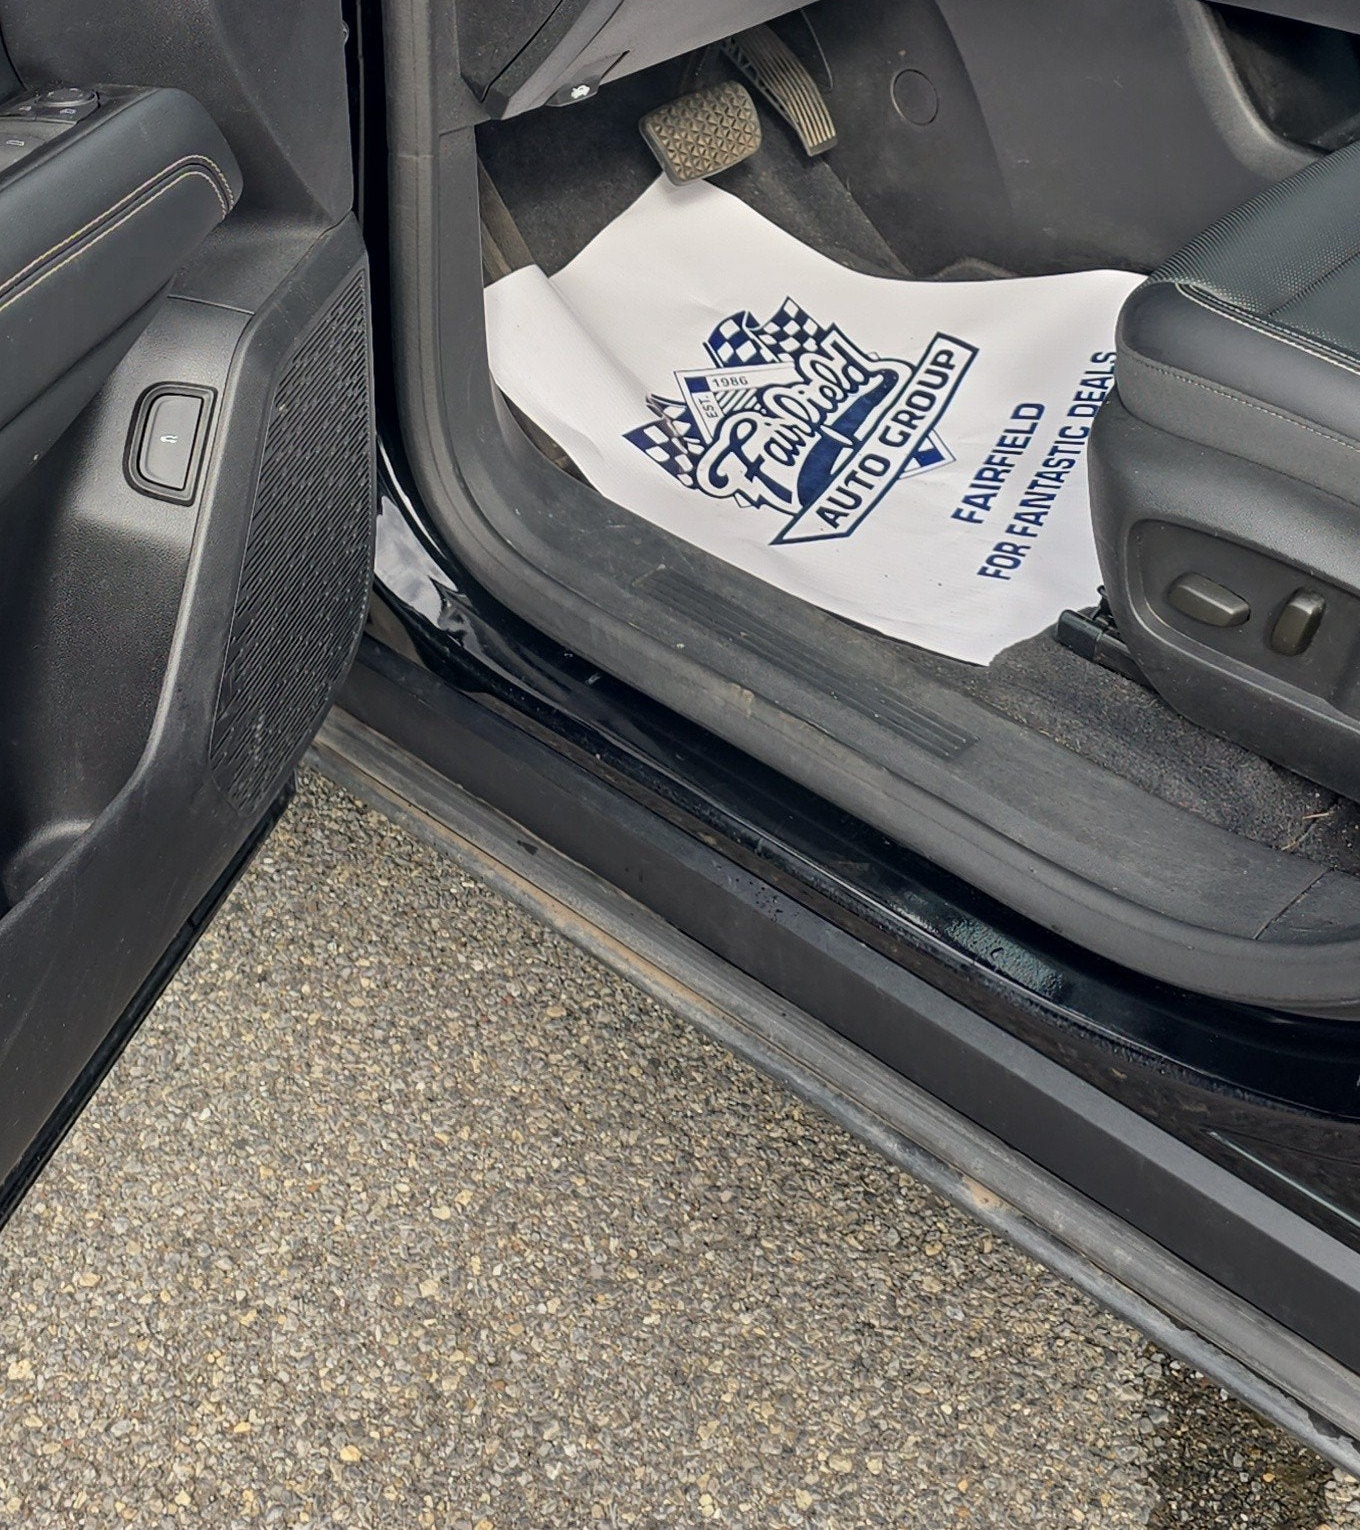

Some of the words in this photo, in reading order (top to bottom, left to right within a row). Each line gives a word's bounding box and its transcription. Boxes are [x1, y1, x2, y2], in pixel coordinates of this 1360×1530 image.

[699, 395, 718, 419] EST.
[708, 339, 876, 504] Fairfield
[712, 376, 749, 388] 1986
[815, 453, 891, 529] AUTO
[878, 349, 955, 447] GROUP
[950, 403, 1046, 524] FAIRFIELD
[976, 541, 1031, 580] FOR
[1005, 425, 1091, 537] FANTASTIC
[1067, 351, 1117, 418] DEALS
